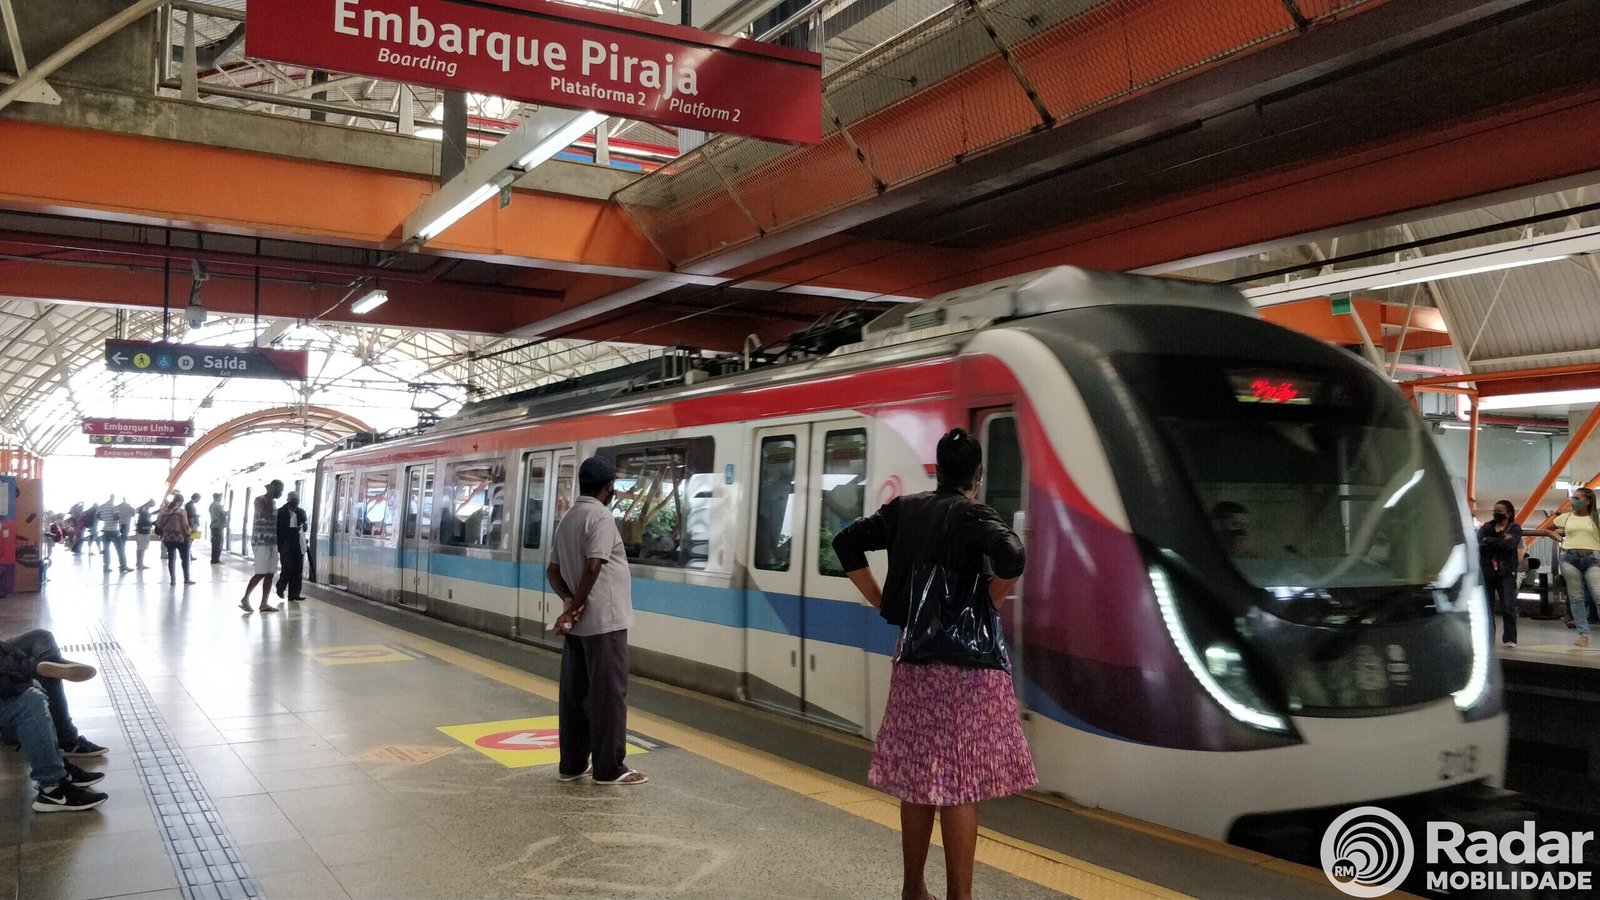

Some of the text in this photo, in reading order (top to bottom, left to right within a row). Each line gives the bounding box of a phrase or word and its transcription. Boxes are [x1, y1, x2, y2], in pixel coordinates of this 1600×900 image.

[334, 0, 567, 72] Embarque
[378, 48, 457, 77] Boarding
[550, 76, 635, 104] Plataforma
[638, 92, 646, 106] 2
[669, 98, 730, 119] Platform
[732, 109, 741, 122] 2
[203, 355, 247, 370] Saída
[103, 422, 190, 435] Embarque Linha 2
